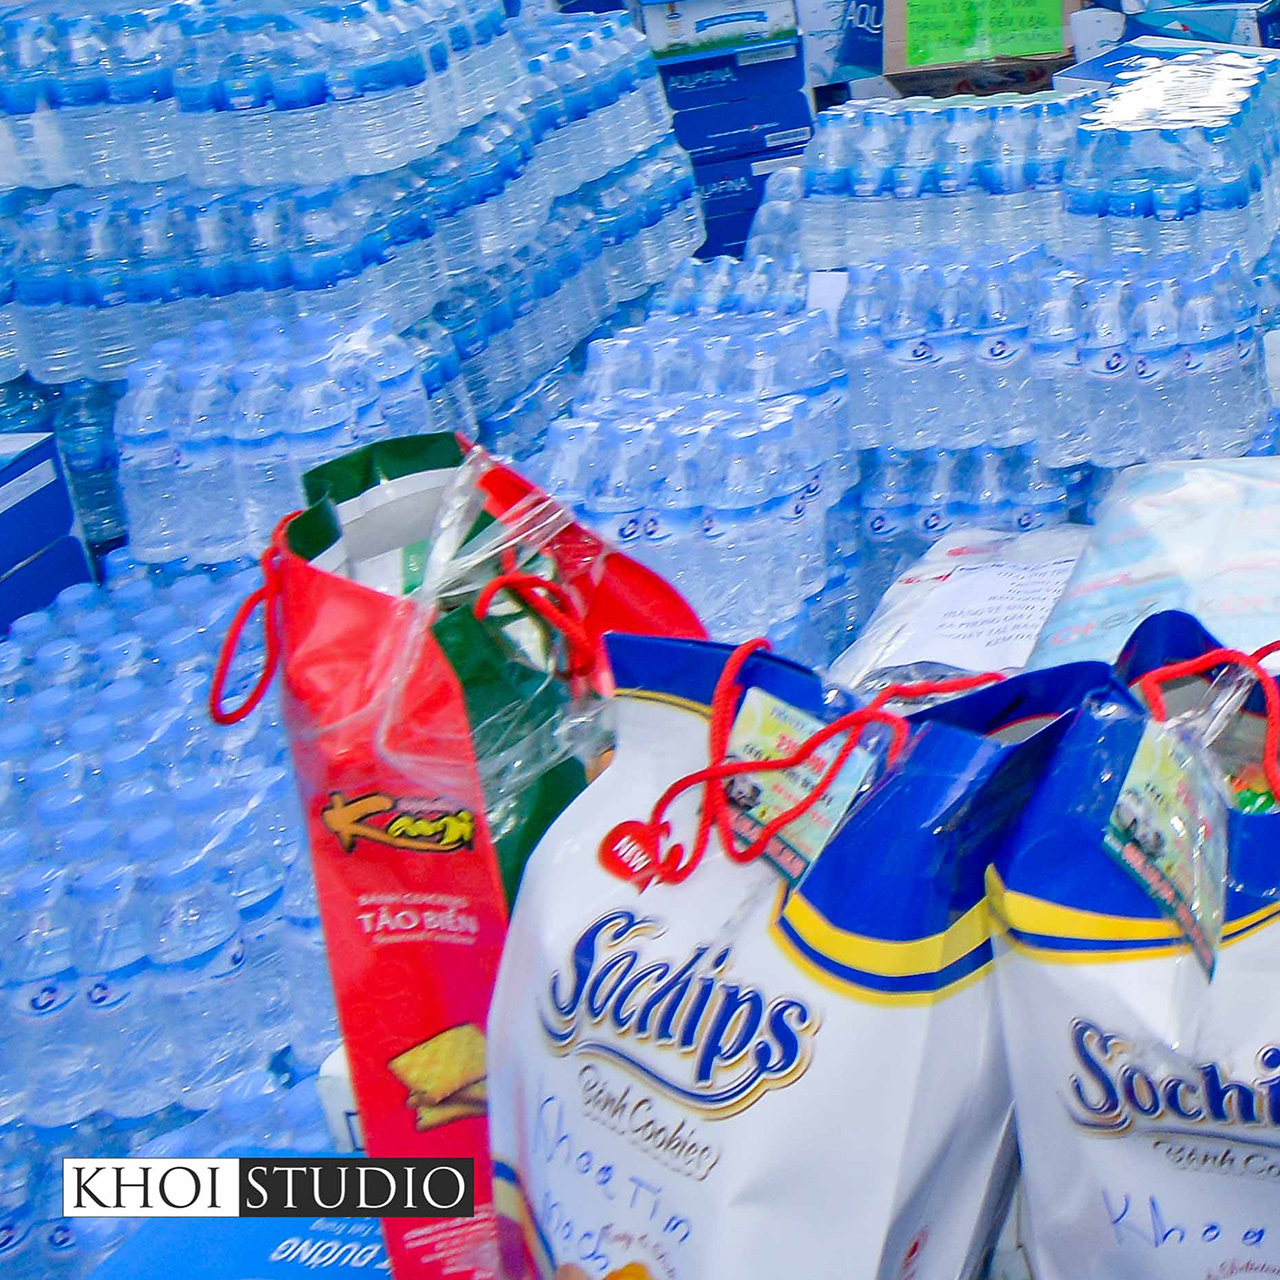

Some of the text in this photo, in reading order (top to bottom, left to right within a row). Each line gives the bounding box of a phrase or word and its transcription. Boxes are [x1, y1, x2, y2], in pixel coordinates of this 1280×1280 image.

[356, 910, 480, 935] TẢO BIỂN
[549, 907, 814, 1088] Sochips
